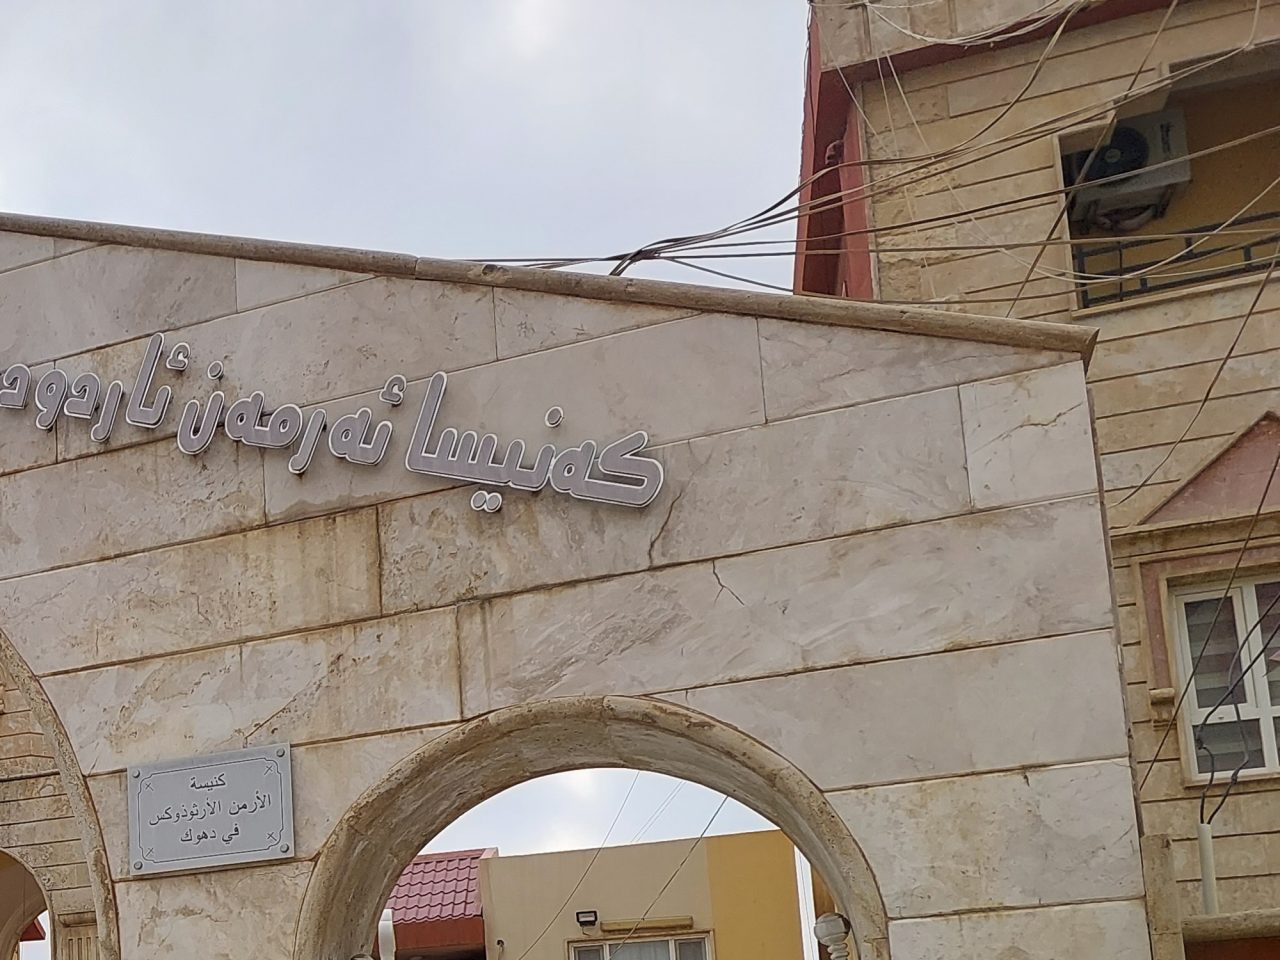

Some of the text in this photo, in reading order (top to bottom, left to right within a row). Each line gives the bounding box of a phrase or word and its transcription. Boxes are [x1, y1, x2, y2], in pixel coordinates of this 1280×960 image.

[190, 773, 227, 792] كنيسة
[180, 823, 240, 846] في دهوك
